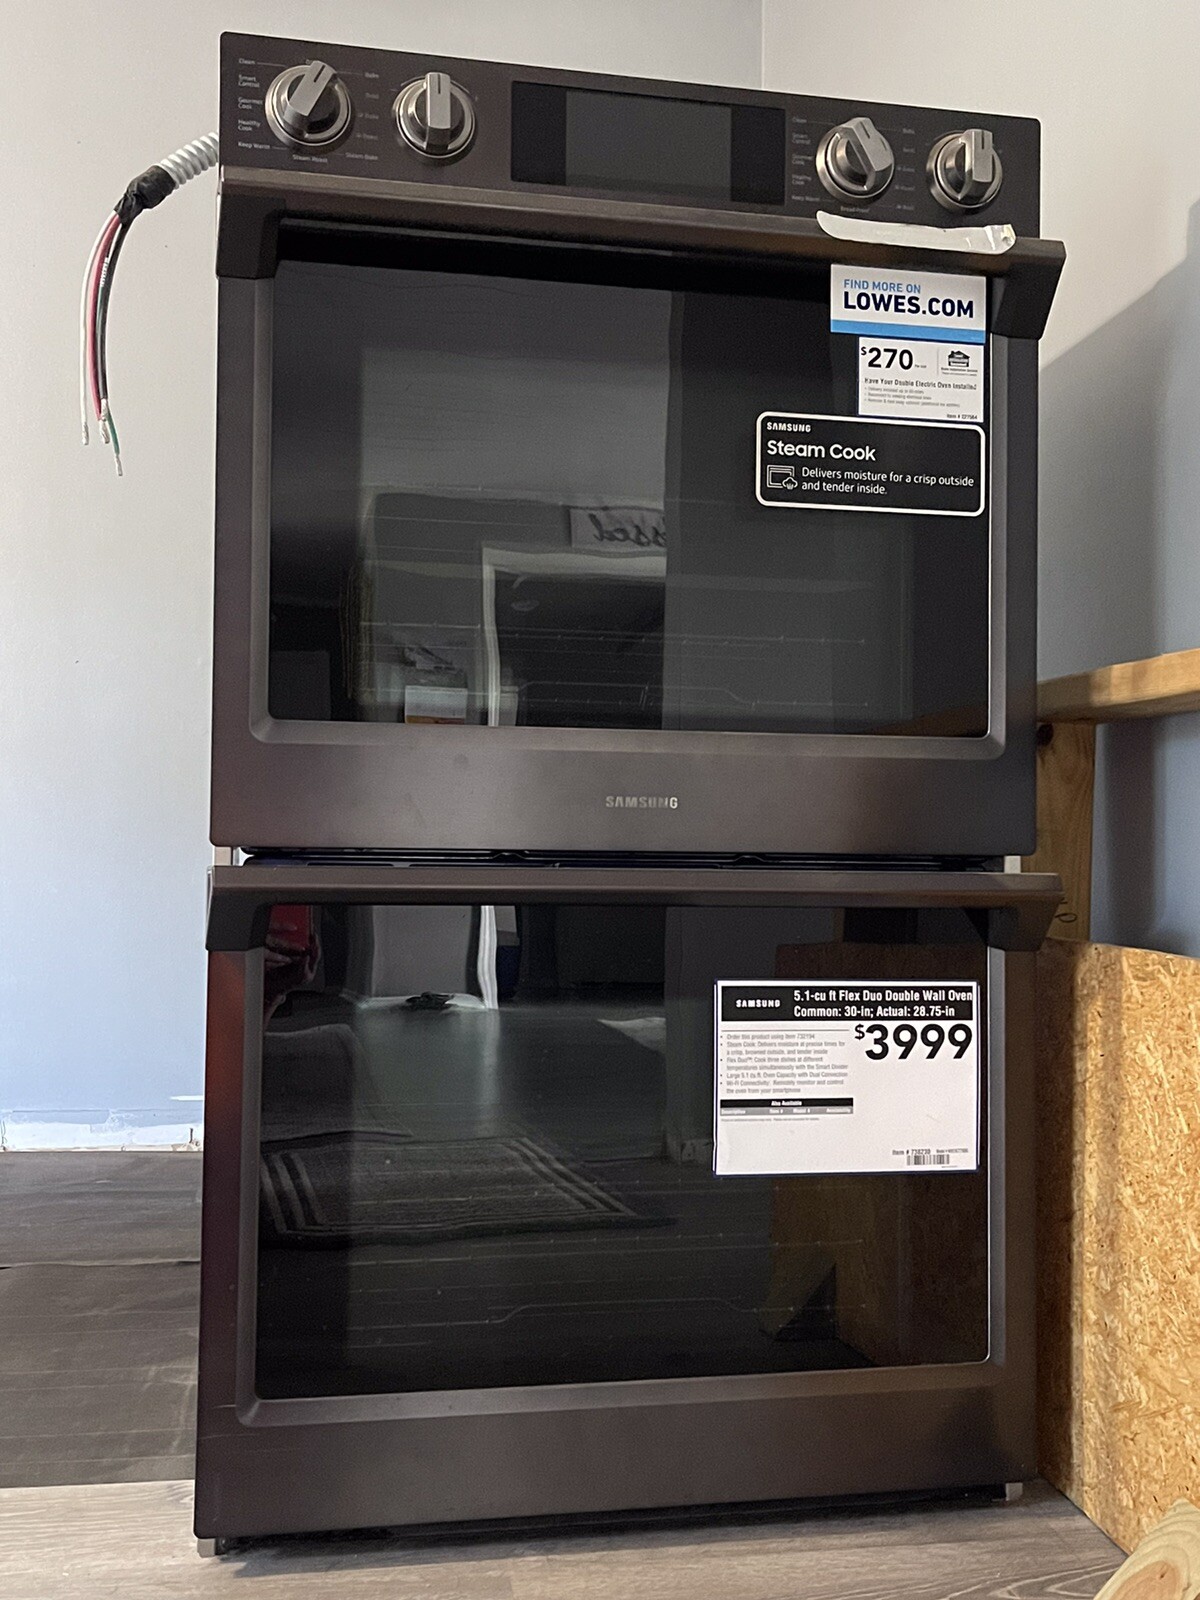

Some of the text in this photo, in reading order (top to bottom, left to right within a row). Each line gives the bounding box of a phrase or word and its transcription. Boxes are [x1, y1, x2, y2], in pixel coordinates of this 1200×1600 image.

[238, 119, 260, 127] Healthy
[843, 279, 921, 294] FIND MORE ON
[843, 291, 974, 318] LOWES.COM
[860, 346, 913, 370] $270
[916, 380, 936, 388] Electric
[767, 422, 811, 433] SAMSUNG
[767, 439, 876, 461] Steam Cook
[802, 467, 974, 487] Delivers moisture for a crisp outside
[801, 480, 887, 495] and tender inside.
[605, 796, 678, 809] SAMSUNG
[794, 990, 973, 1001] 5.1-cu ft Flex Duo Double Wall Oven
[735, 999, 781, 1008] SAMSUNG
[794, 1005, 955, 1018] Common: 30-in; Actual: 28.75-in
[854, 1023, 972, 1060] $3999
